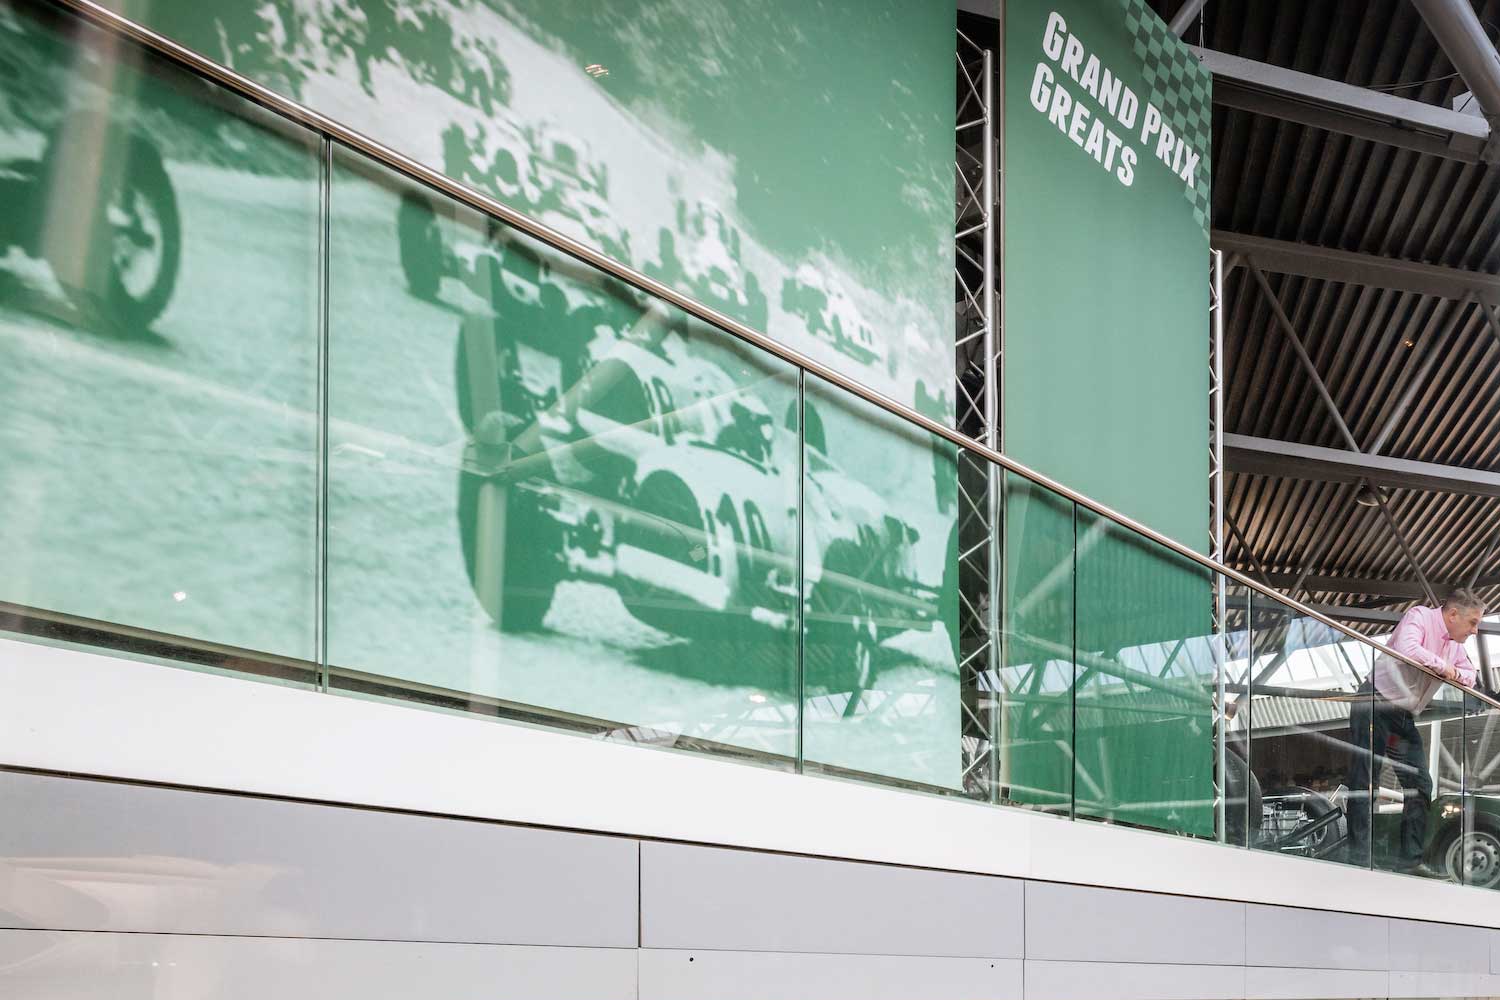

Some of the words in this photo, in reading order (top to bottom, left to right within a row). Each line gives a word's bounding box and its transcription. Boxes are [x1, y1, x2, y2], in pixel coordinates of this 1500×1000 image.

[1029, 62, 1138, 187] GREATS
[1042, 11, 1138, 130] GRAND
[1140, 101, 1200, 188] PRIX
